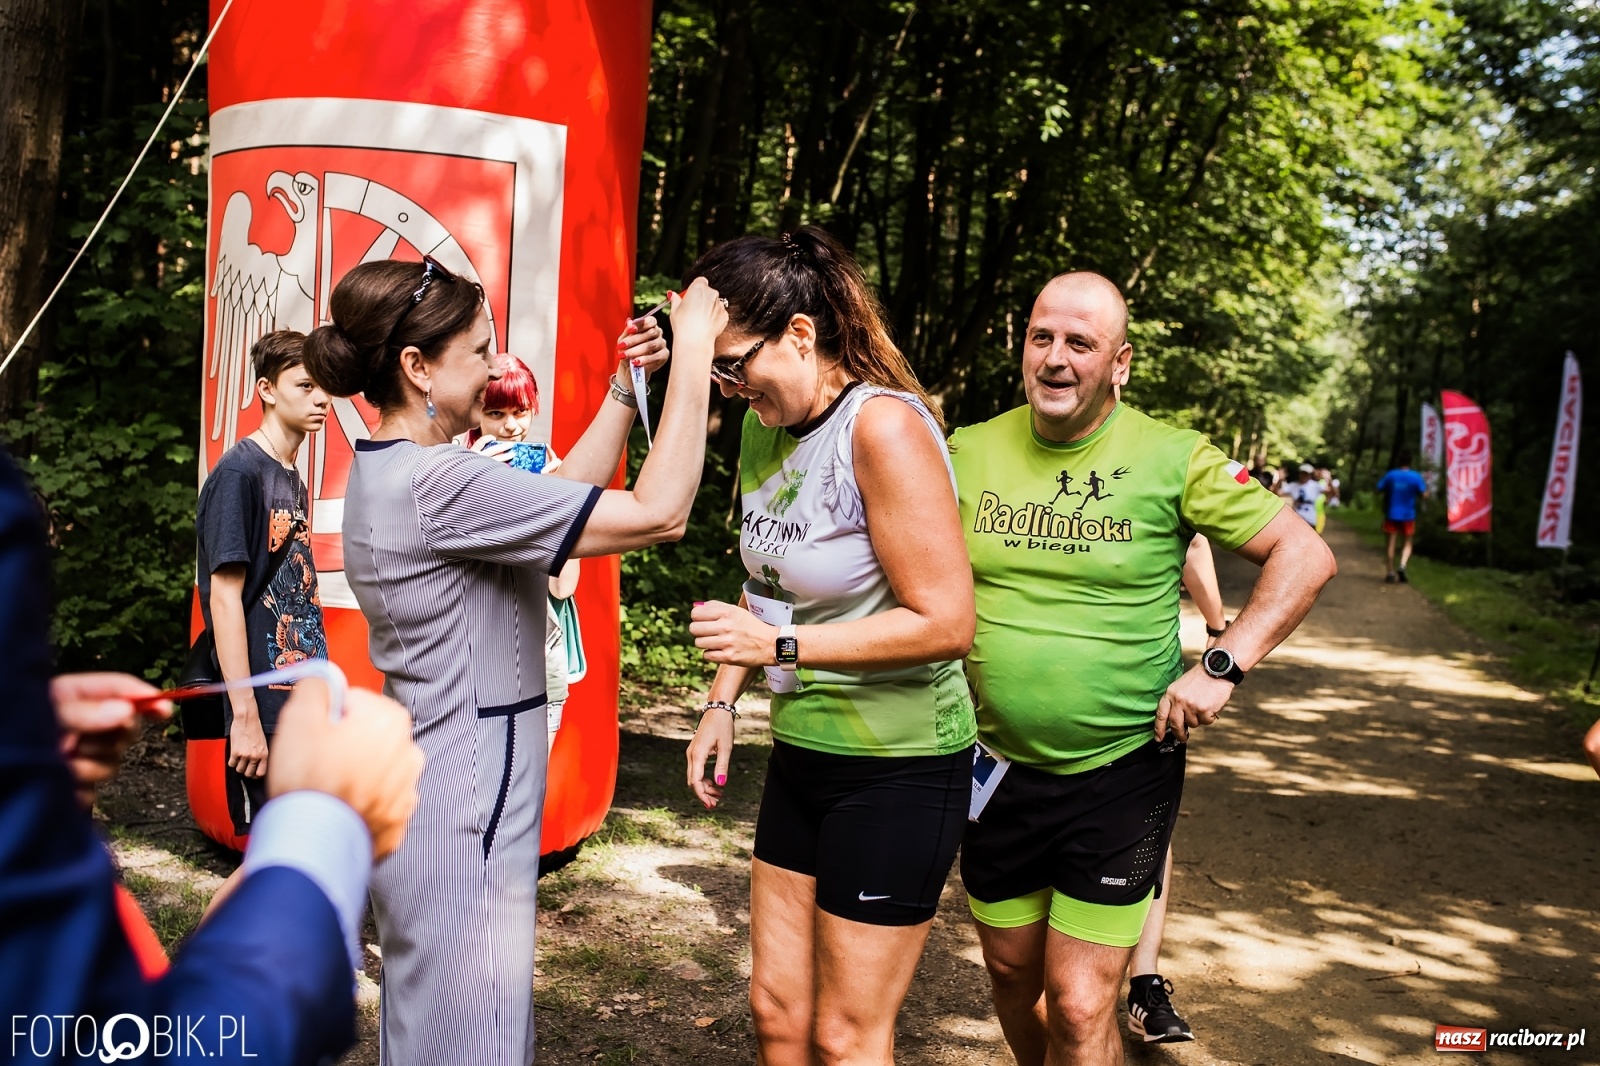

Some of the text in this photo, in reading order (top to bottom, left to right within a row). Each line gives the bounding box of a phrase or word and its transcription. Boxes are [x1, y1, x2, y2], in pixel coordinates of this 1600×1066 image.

[974, 490, 1132, 542] Radlinioki
[1004, 538, 1091, 554] w biegu
